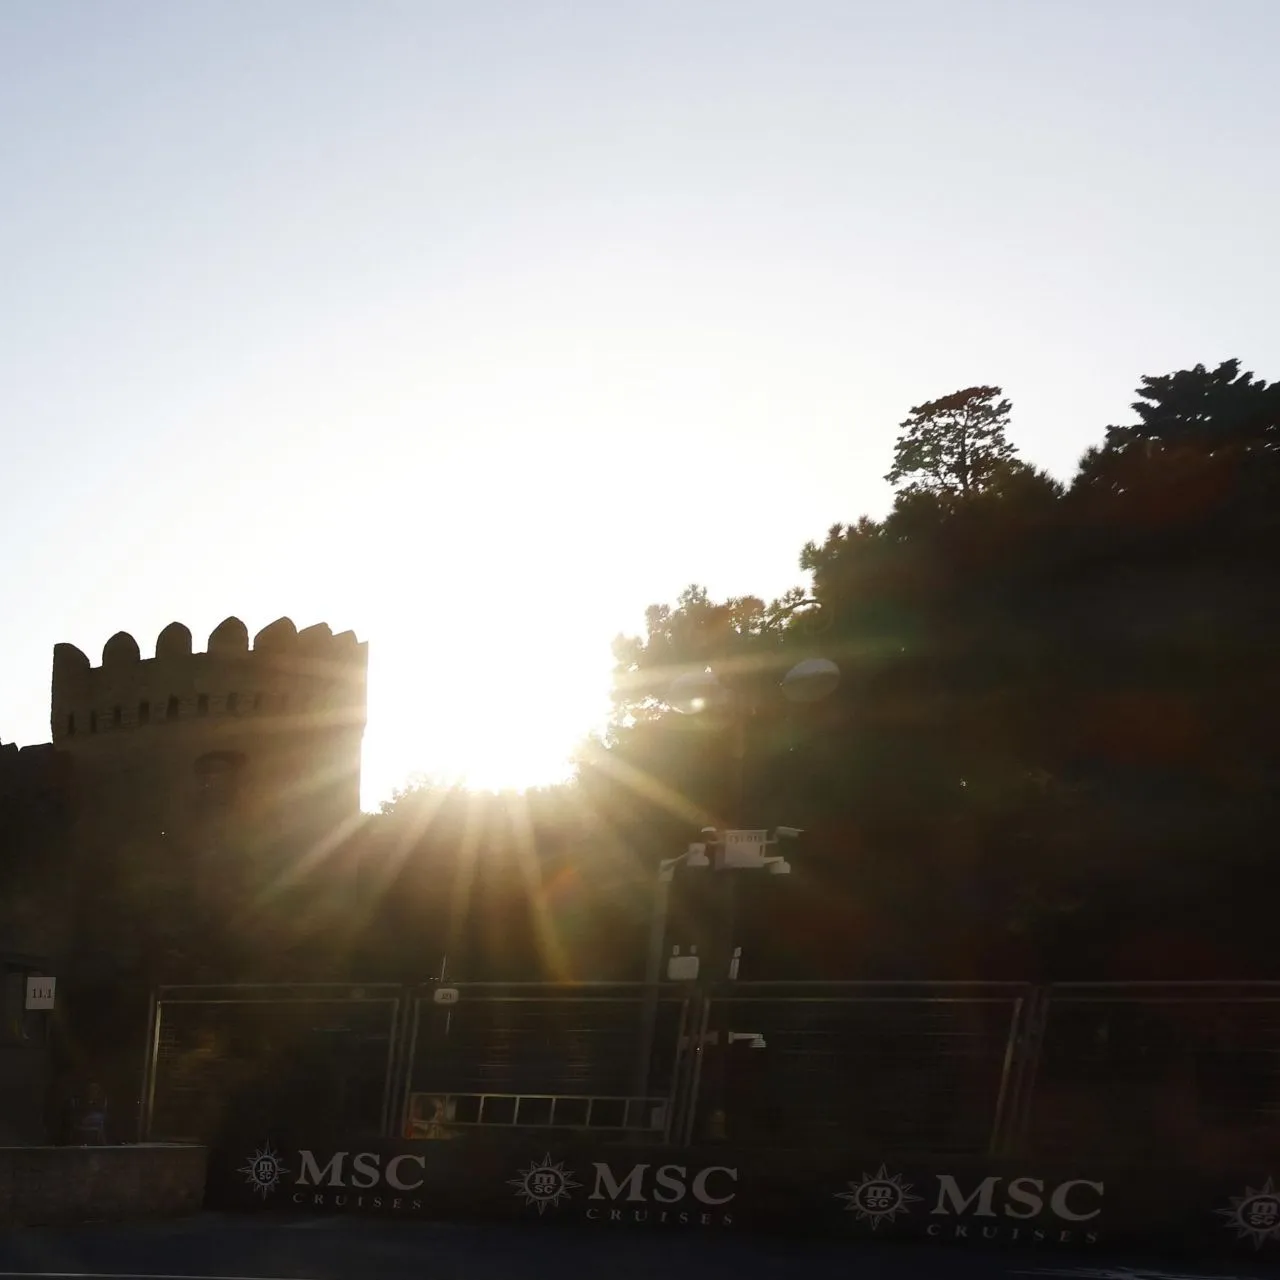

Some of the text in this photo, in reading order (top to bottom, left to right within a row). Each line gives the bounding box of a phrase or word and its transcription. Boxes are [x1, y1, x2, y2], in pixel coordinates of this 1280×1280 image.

[294, 1149, 427, 1190] MSC
[587, 1162, 740, 1206] MSC
[293, 1192, 424, 1210] CRUISES
[928, 1173, 1106, 1222] MSC
[585, 1207, 735, 1227] CRUISES
[925, 1222, 1101, 1245] CRUISES
